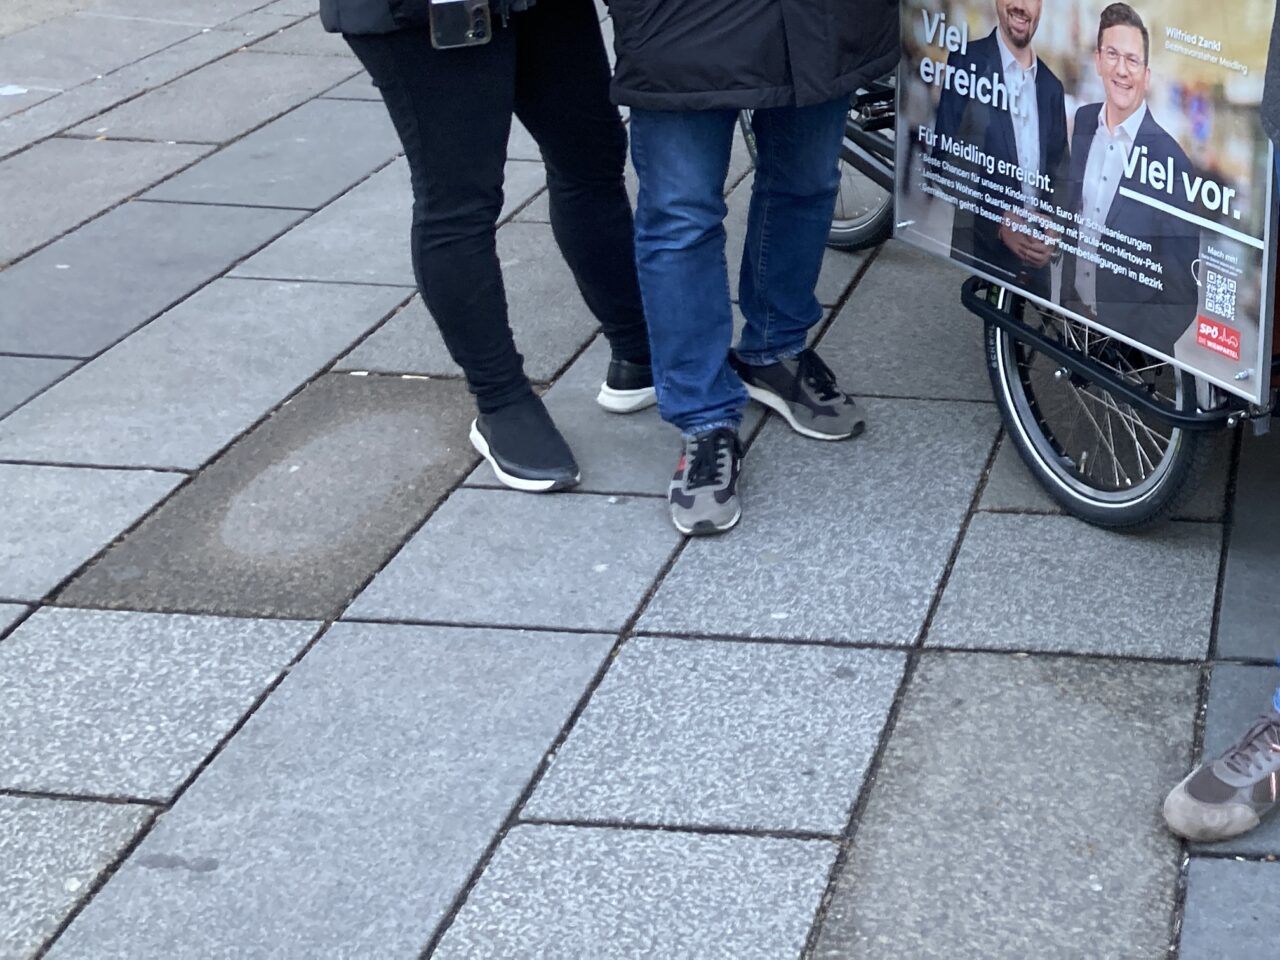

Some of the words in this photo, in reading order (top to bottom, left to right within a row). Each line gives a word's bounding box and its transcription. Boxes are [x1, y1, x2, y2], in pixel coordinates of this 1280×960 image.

[922, 8, 968, 55] Viel
[1165, 26, 1197, 45] Wilfried
[919, 56, 1028, 119] erreicht.
[1219, 56, 1248, 76] Meidling
[918, 125, 938, 147] Für
[941, 134, 995, 174] Meidling
[998, 159, 1055, 194] erreicht.
[1120, 142, 1174, 195] Viel
[1182, 171, 1241, 220] vor.
[942, 161, 970, 180] Chancen
[970, 172, 980, 184] für
[981, 178, 1004, 193] unsere
[1039, 199, 1055, 215] Mio.
[1056, 206, 1073, 221] Euro
[1073, 212, 1085, 225] für
[1085, 217, 1152, 252] Schulsanierungen
[955, 182, 984, 201] Wohnen:
[984, 193, 1012, 212] Quartier
[1012, 206, 1065, 234] Wolfganggasse
[1066, 227, 1078, 240] mit
[980, 206, 1005, 224] besser:
[1005, 218, 1011, 227] 5
[1011, 221, 1032, 235] große
[1128, 269, 1137, 280] im
[1138, 271, 1164, 291] Bezirk
[1207, 245, 1224, 259] Mach
[1199, 323, 1219, 339] SPÖ
